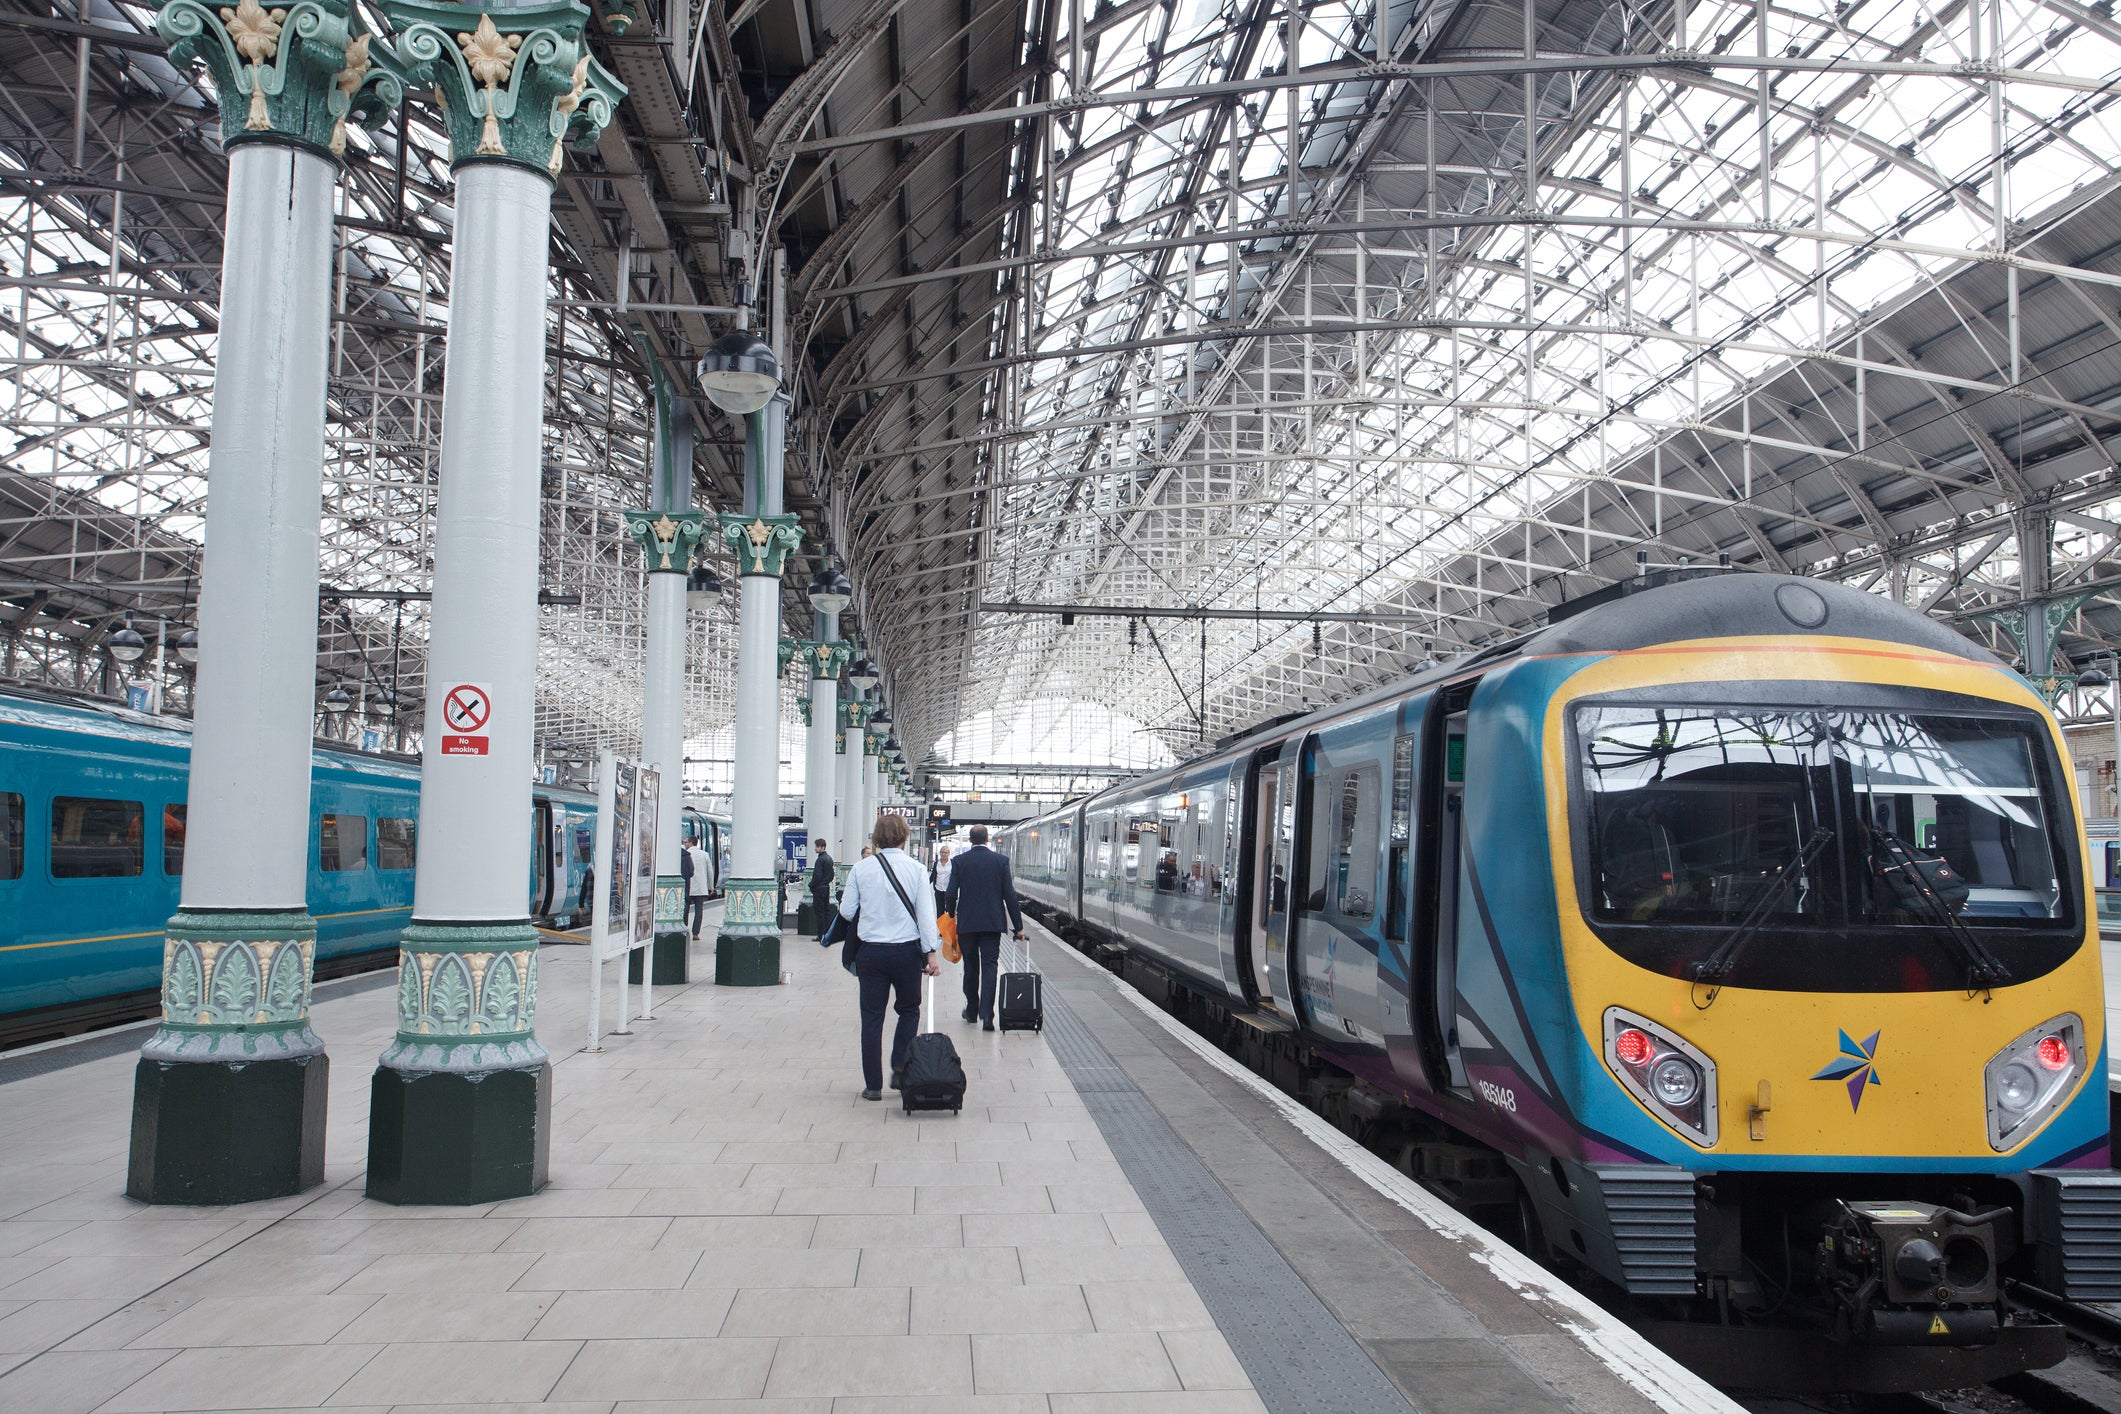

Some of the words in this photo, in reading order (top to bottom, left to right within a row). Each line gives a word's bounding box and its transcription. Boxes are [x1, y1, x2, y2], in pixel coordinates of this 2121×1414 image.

[449, 747, 479, 755] smoking
[933, 809, 946, 817] OFF
[1479, 1079, 1516, 1112] 185148
